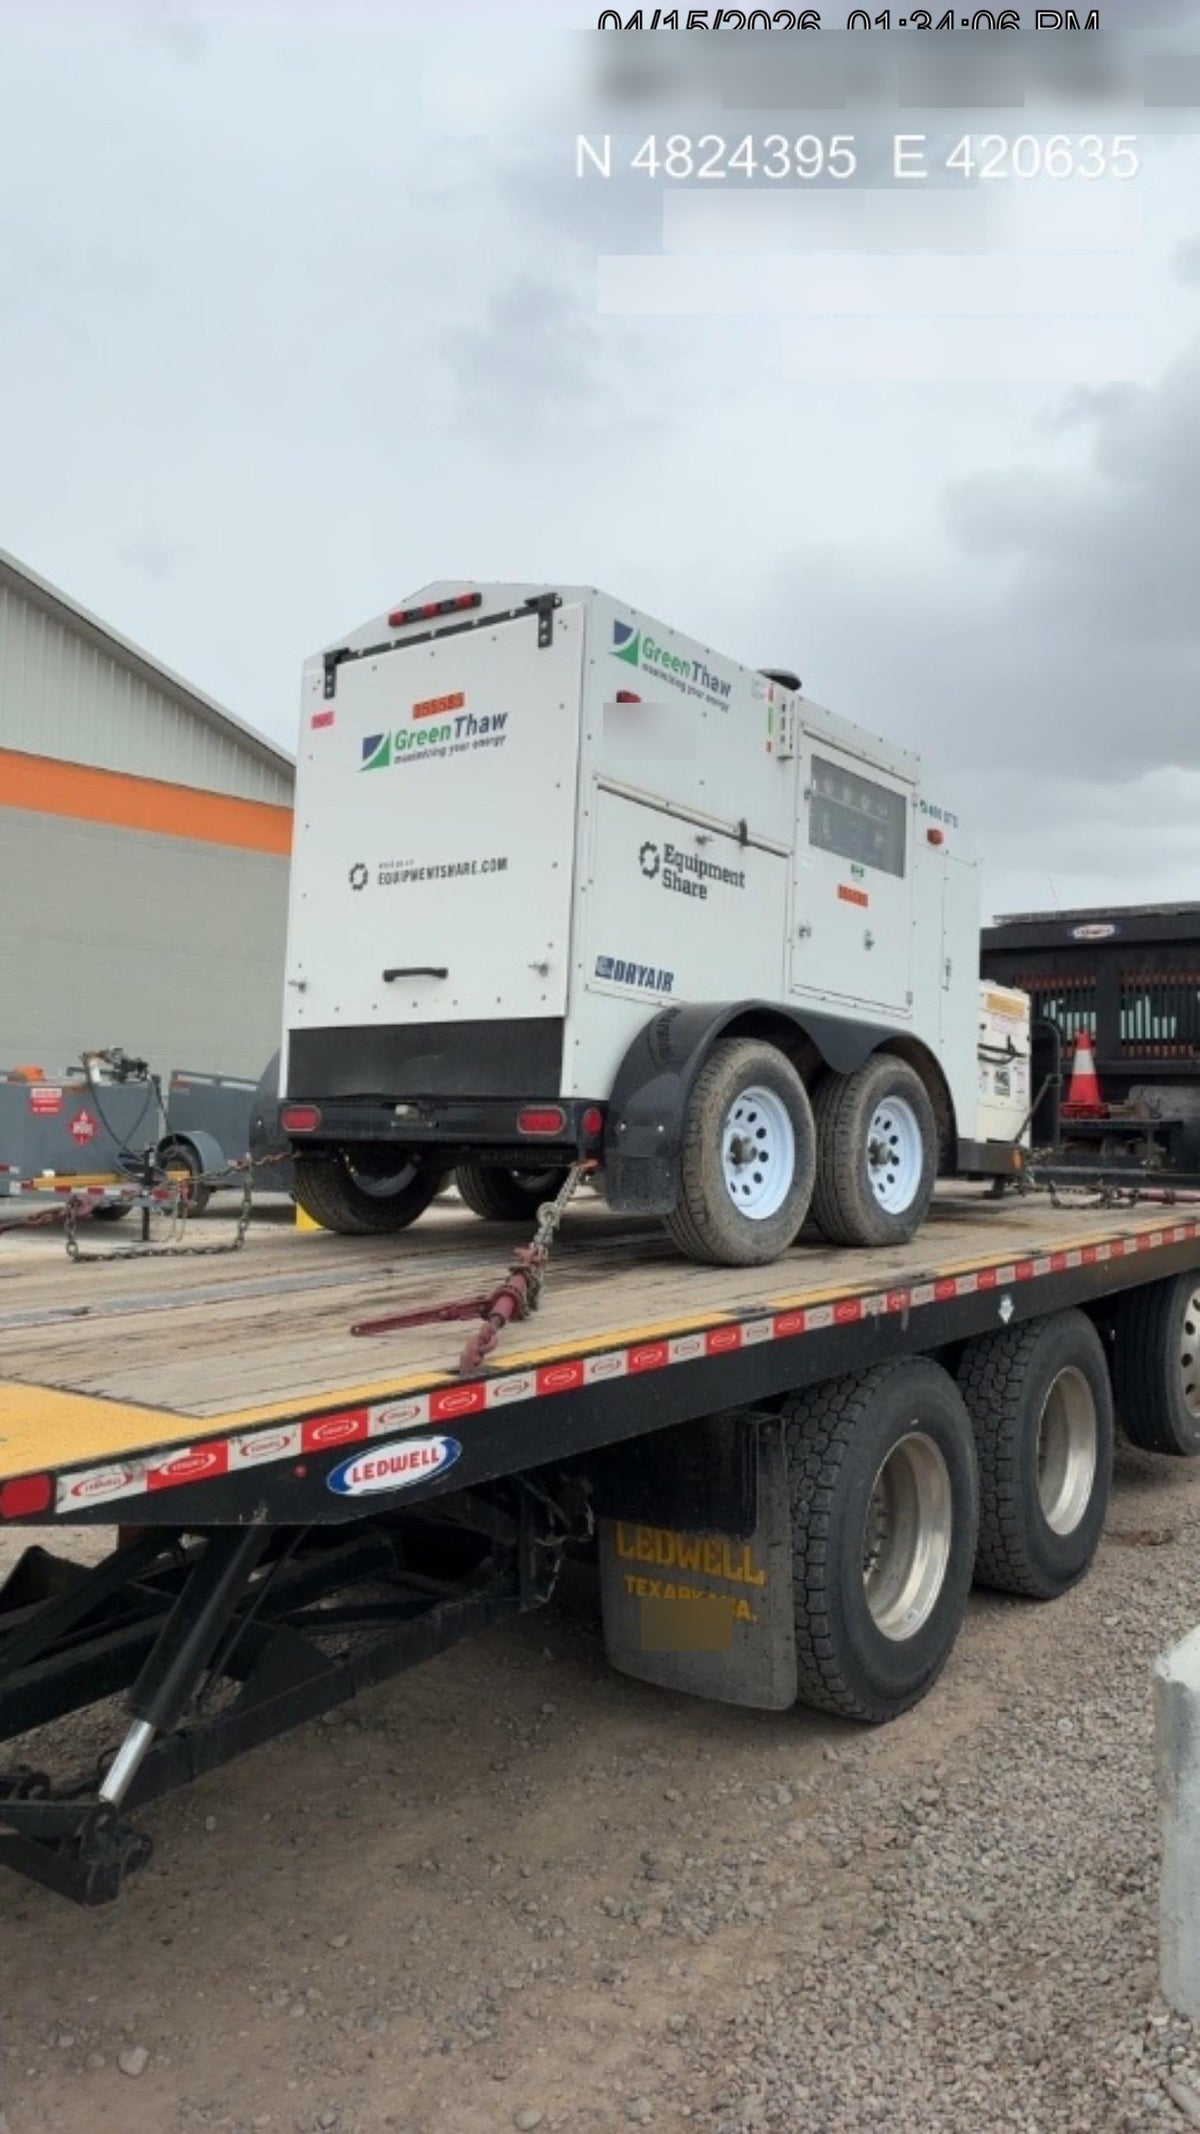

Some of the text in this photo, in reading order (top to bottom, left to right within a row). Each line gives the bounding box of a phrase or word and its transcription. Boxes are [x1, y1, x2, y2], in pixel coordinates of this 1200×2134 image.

[378, 857, 508, 886] EQUIPMENTSHARE.COM
[662, 867, 708, 900] Share
[664, 843, 746, 889] Equipment
[613, 959, 675, 993] DRYAIR
[352, 1447, 439, 1483] LEDWELL
[616, 1522, 766, 1586] LEDWELL
